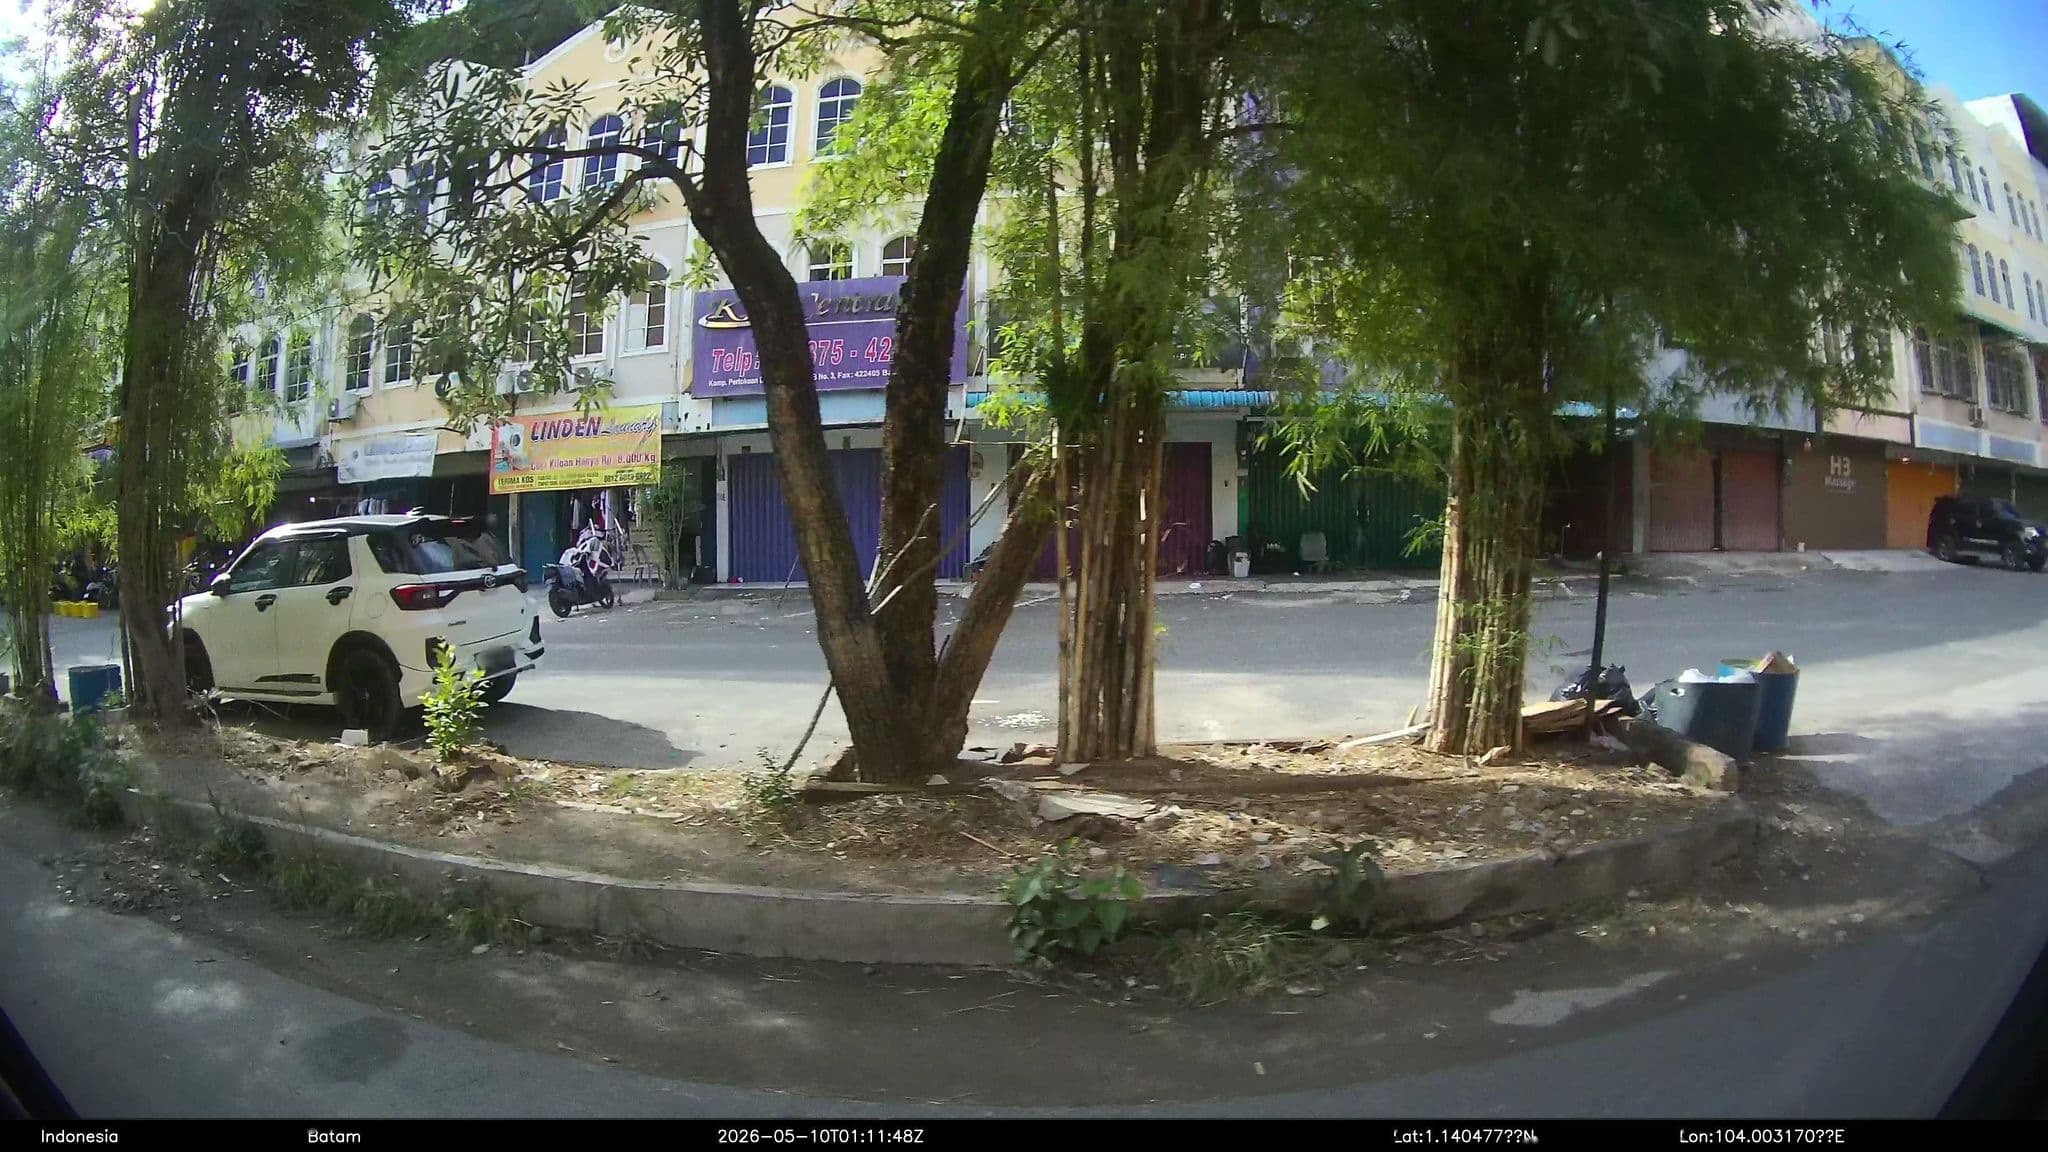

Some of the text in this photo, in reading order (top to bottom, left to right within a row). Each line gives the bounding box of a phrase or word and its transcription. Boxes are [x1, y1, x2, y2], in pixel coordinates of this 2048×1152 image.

[712, 346, 761, 378] Telp:
[864, 336, 892, 363] 42
[708, 379, 728, 387] Komp.
[837, 370, 854, 379] Fax:
[854, 368, 880, 378] 422405
[530, 416, 602, 442] LINDEN
[643, 450, 656, 464] Kg
[1830, 455, 1850, 477] H3
